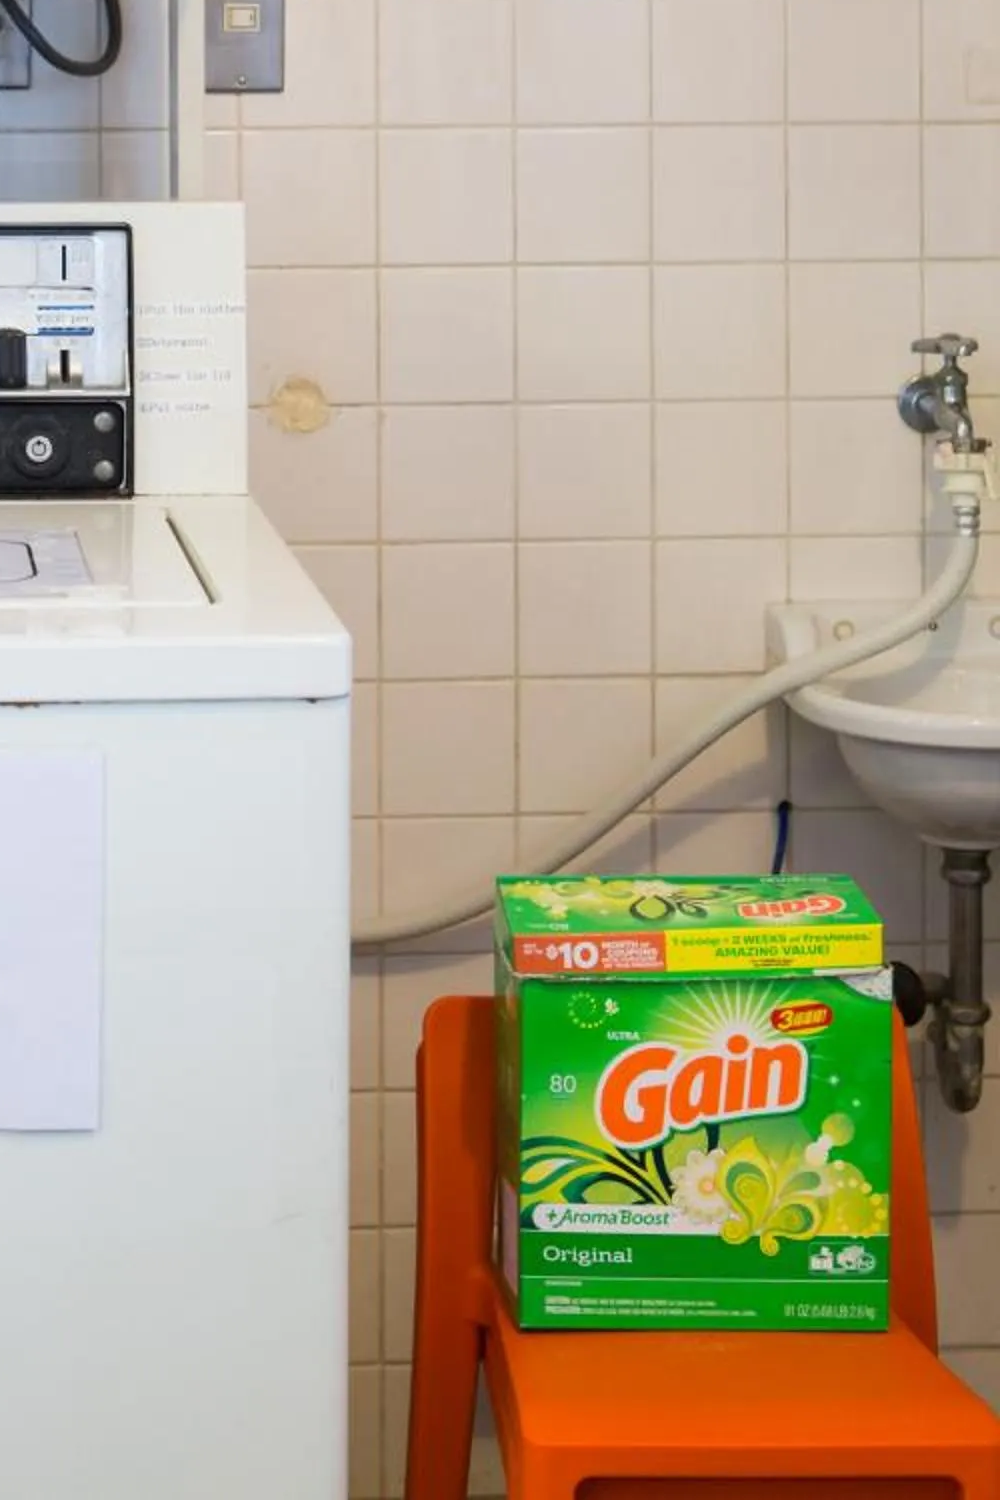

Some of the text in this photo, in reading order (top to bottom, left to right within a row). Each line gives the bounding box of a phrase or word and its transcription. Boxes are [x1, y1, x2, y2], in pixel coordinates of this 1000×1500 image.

[545, 941, 599, 969] $10
[715, 945, 830, 957] AMAZING VALUE!
[549, 1075, 576, 1093] 80
[598, 1033, 806, 1146] Gain
[543, 1246, 633, 1264] Original
